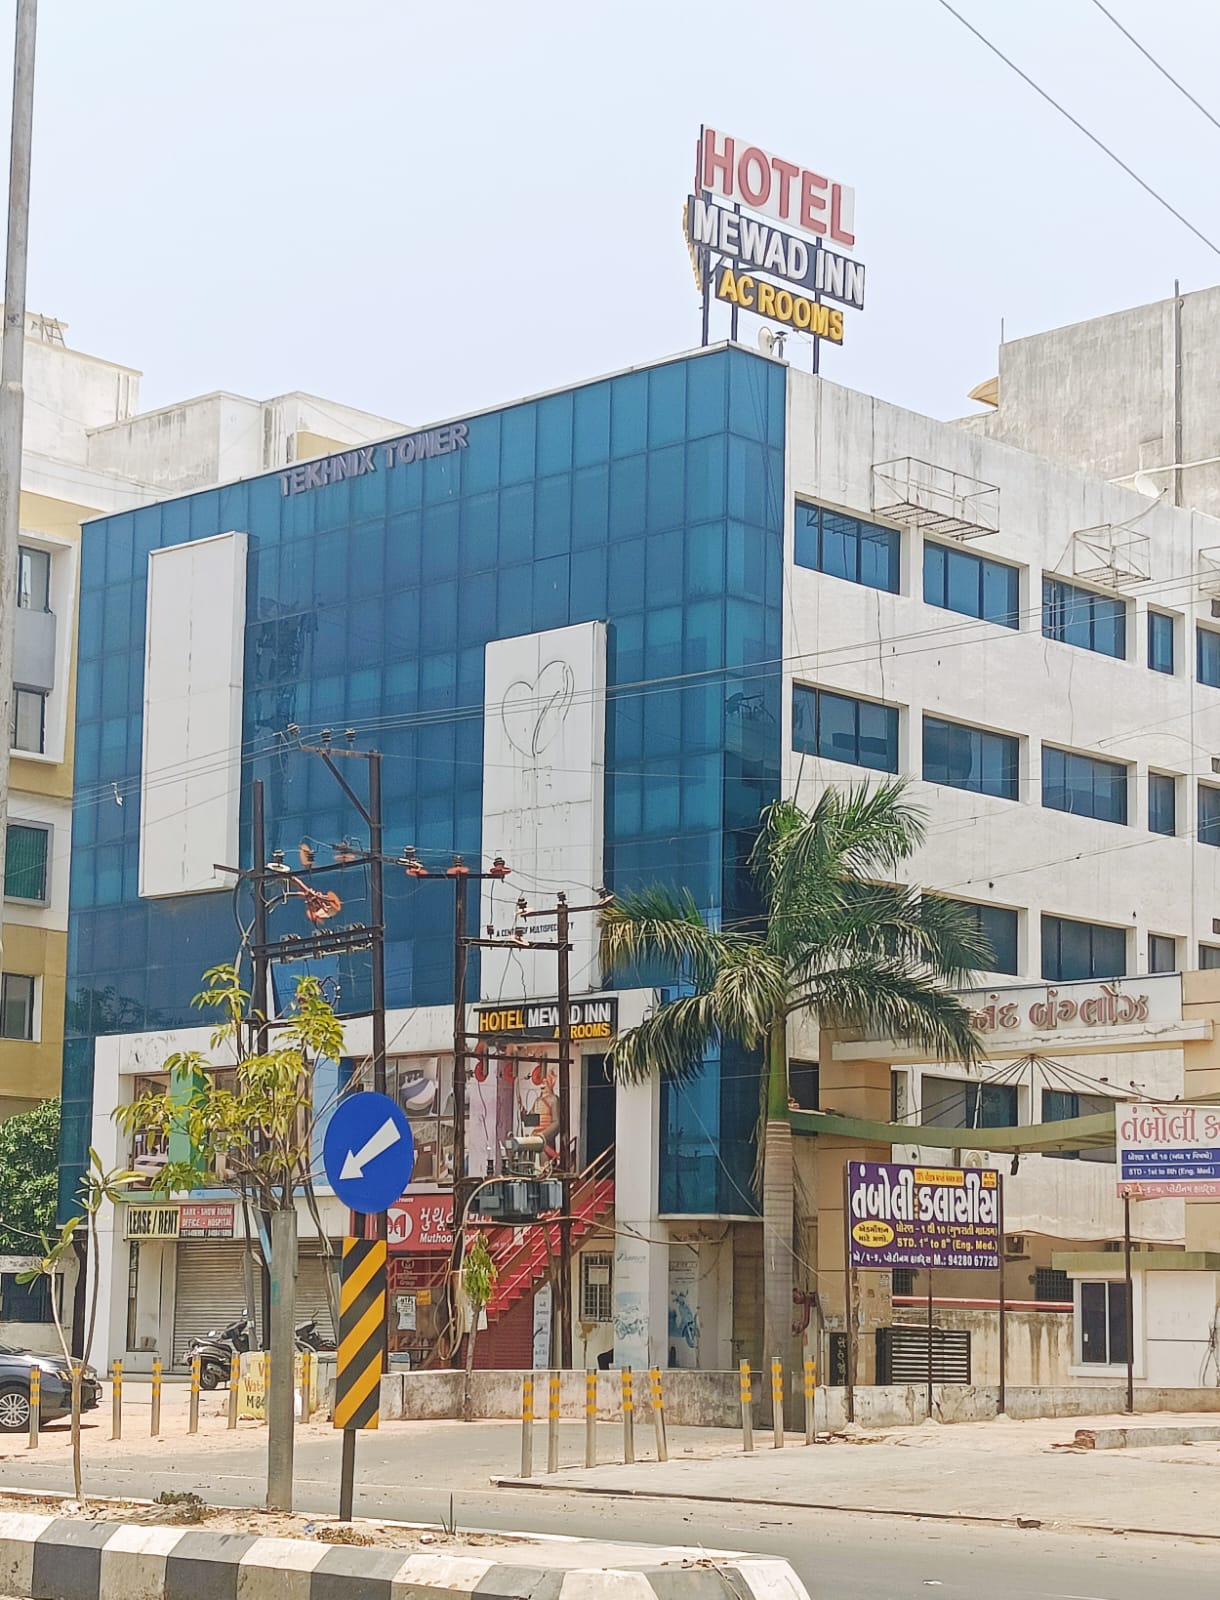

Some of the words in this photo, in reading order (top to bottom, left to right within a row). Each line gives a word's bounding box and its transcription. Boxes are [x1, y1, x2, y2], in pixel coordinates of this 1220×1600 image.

[703, 129, 855, 246] HOTEL
[693, 199, 809, 280] MEWAD
[815, 249, 865, 306] INN
[718, 268, 755, 307] AC
[757, 281, 844, 340] ROOMS
[278, 447, 376, 497] TEKHNIX
[383, 423, 470, 469] TOWER
[479, 1009, 526, 1032] HOTEL
[528, 1004, 581, 1028] MEWD
[584, 1002, 611, 1023] INN
[570, 1023, 611, 1039] ROOMS
[1120, 1107, 1200, 1144] તંબોલી
[852, 1164, 914, 1221] તંબોલી
[129, 1210, 151, 1235] LEASE
[158, 1209, 179, 1235] RENT
[419, 1233, 453, 1243] Muthoo
[897, 1237, 917, 1248] STD.
[930, 1239, 939, 1248] to
[952, 1239, 974, 1252] (Eng.
[975, 1240, 998, 1252] Med.)
[947, 1254, 973, 1266] 94280
[974, 1255, 998, 1267] 67720
